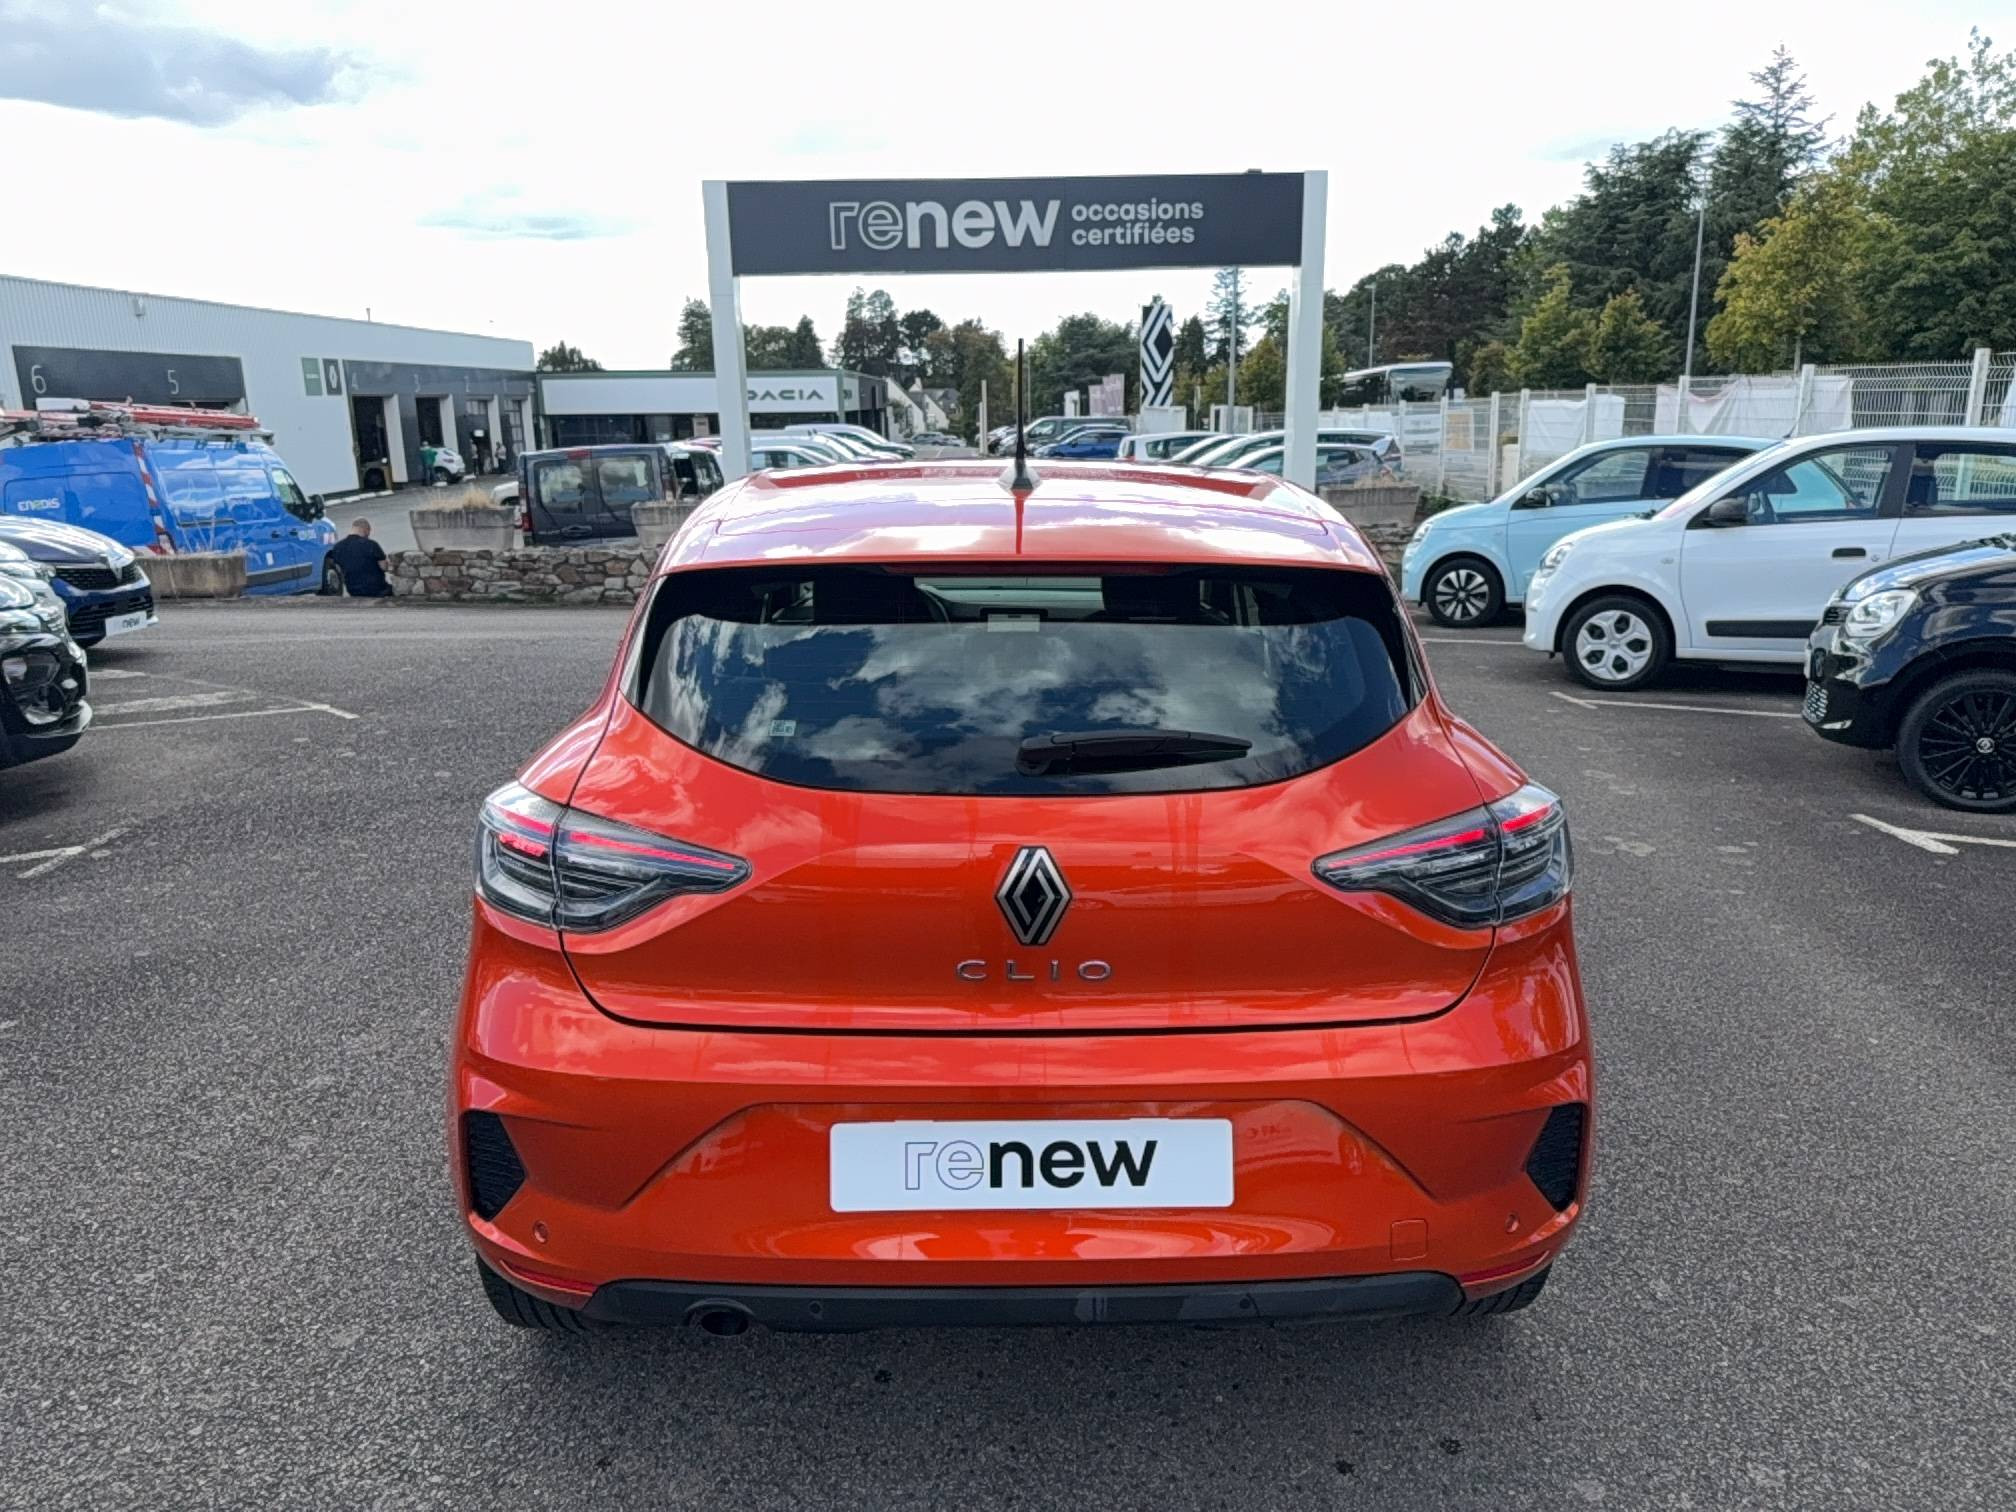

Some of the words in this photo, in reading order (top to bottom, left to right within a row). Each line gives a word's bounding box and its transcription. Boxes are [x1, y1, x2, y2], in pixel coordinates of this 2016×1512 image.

[1071, 198, 1204, 222] occasions
[829, 199, 1061, 251] renew
[1071, 222, 1195, 246] certifiées
[31, 364, 47, 394] 6
[167, 369, 180, 395] 5
[747, 389, 824, 401] DACIA
[957, 959, 1111, 981] CLIO
[905, 1139, 1158, 1191] renew
